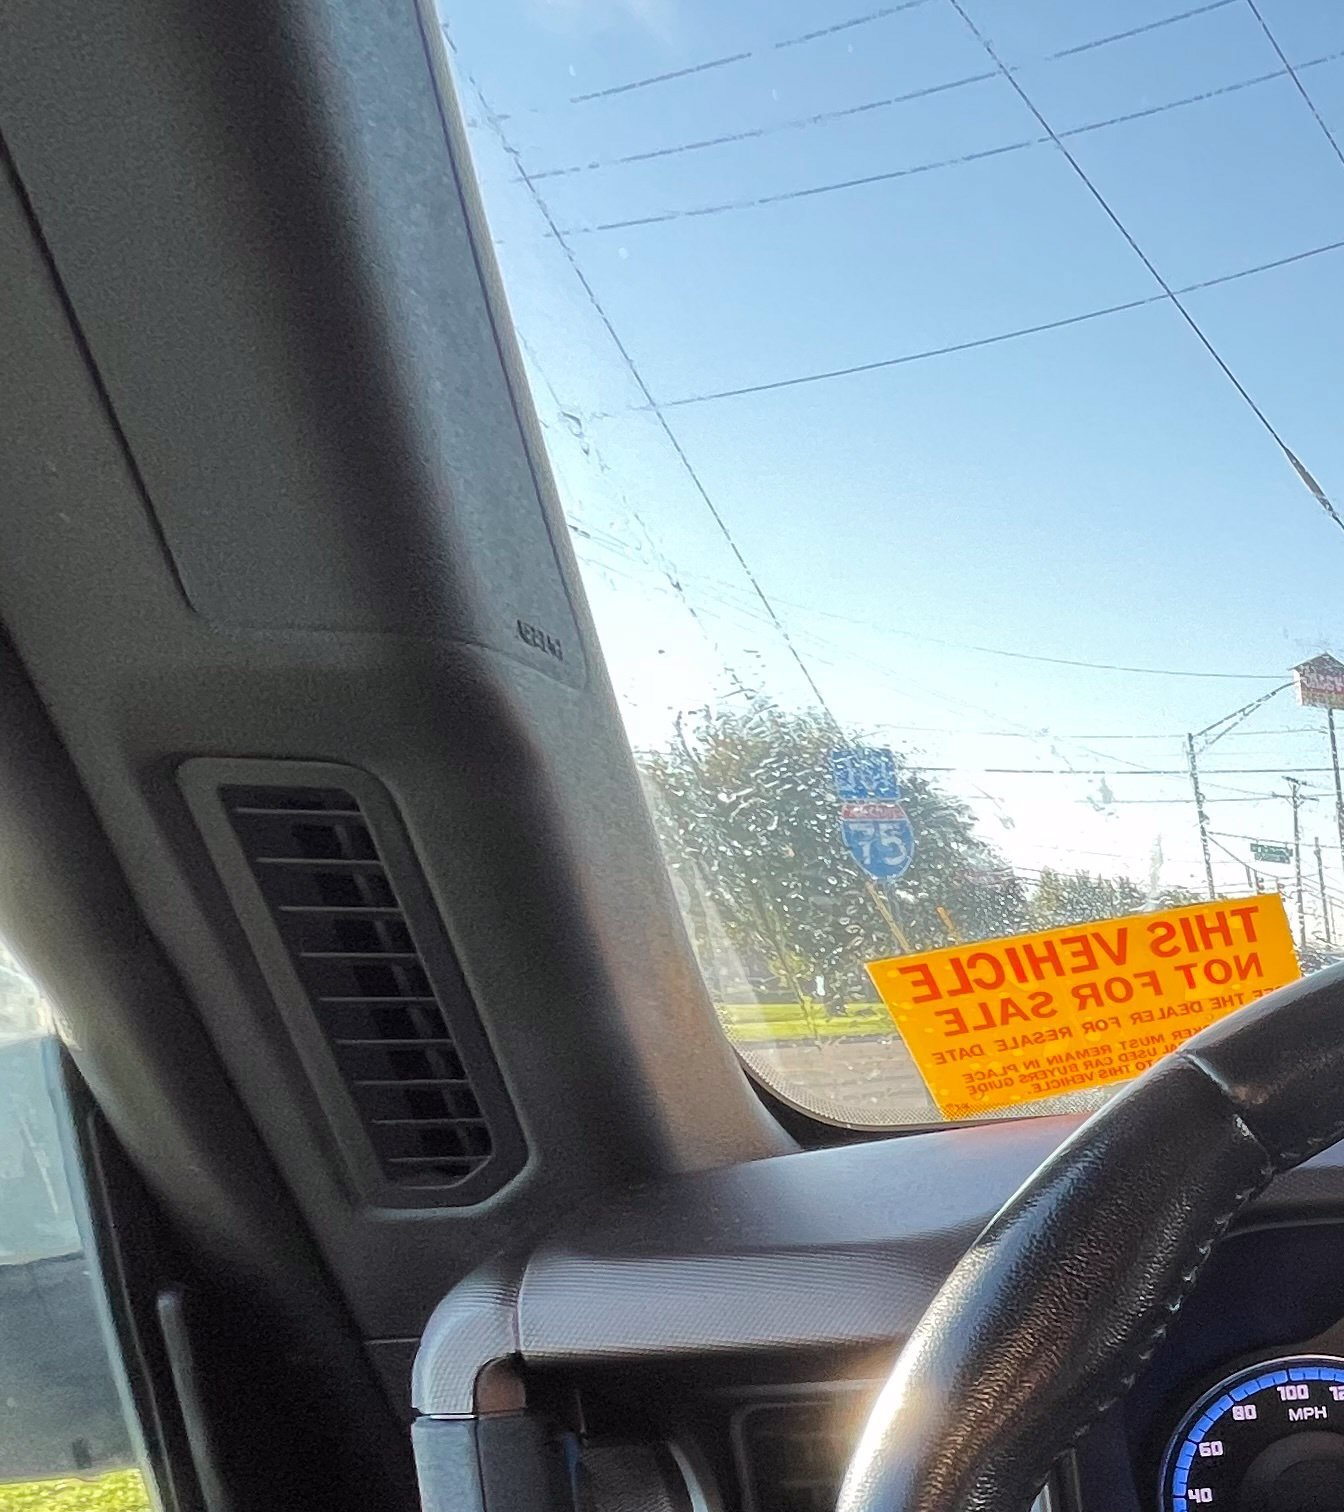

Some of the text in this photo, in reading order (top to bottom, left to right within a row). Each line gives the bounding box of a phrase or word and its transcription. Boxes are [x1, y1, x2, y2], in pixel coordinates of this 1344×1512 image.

[848, 823, 906, 866] 75
[1276, 1384, 1309, 1401] 100
[1232, 1405, 1257, 1421] 80
[1288, 1406, 1328, 1421] MPH
[1199, 1440, 1224, 1457] 60
[1187, 1487, 1213, 1503] 40
